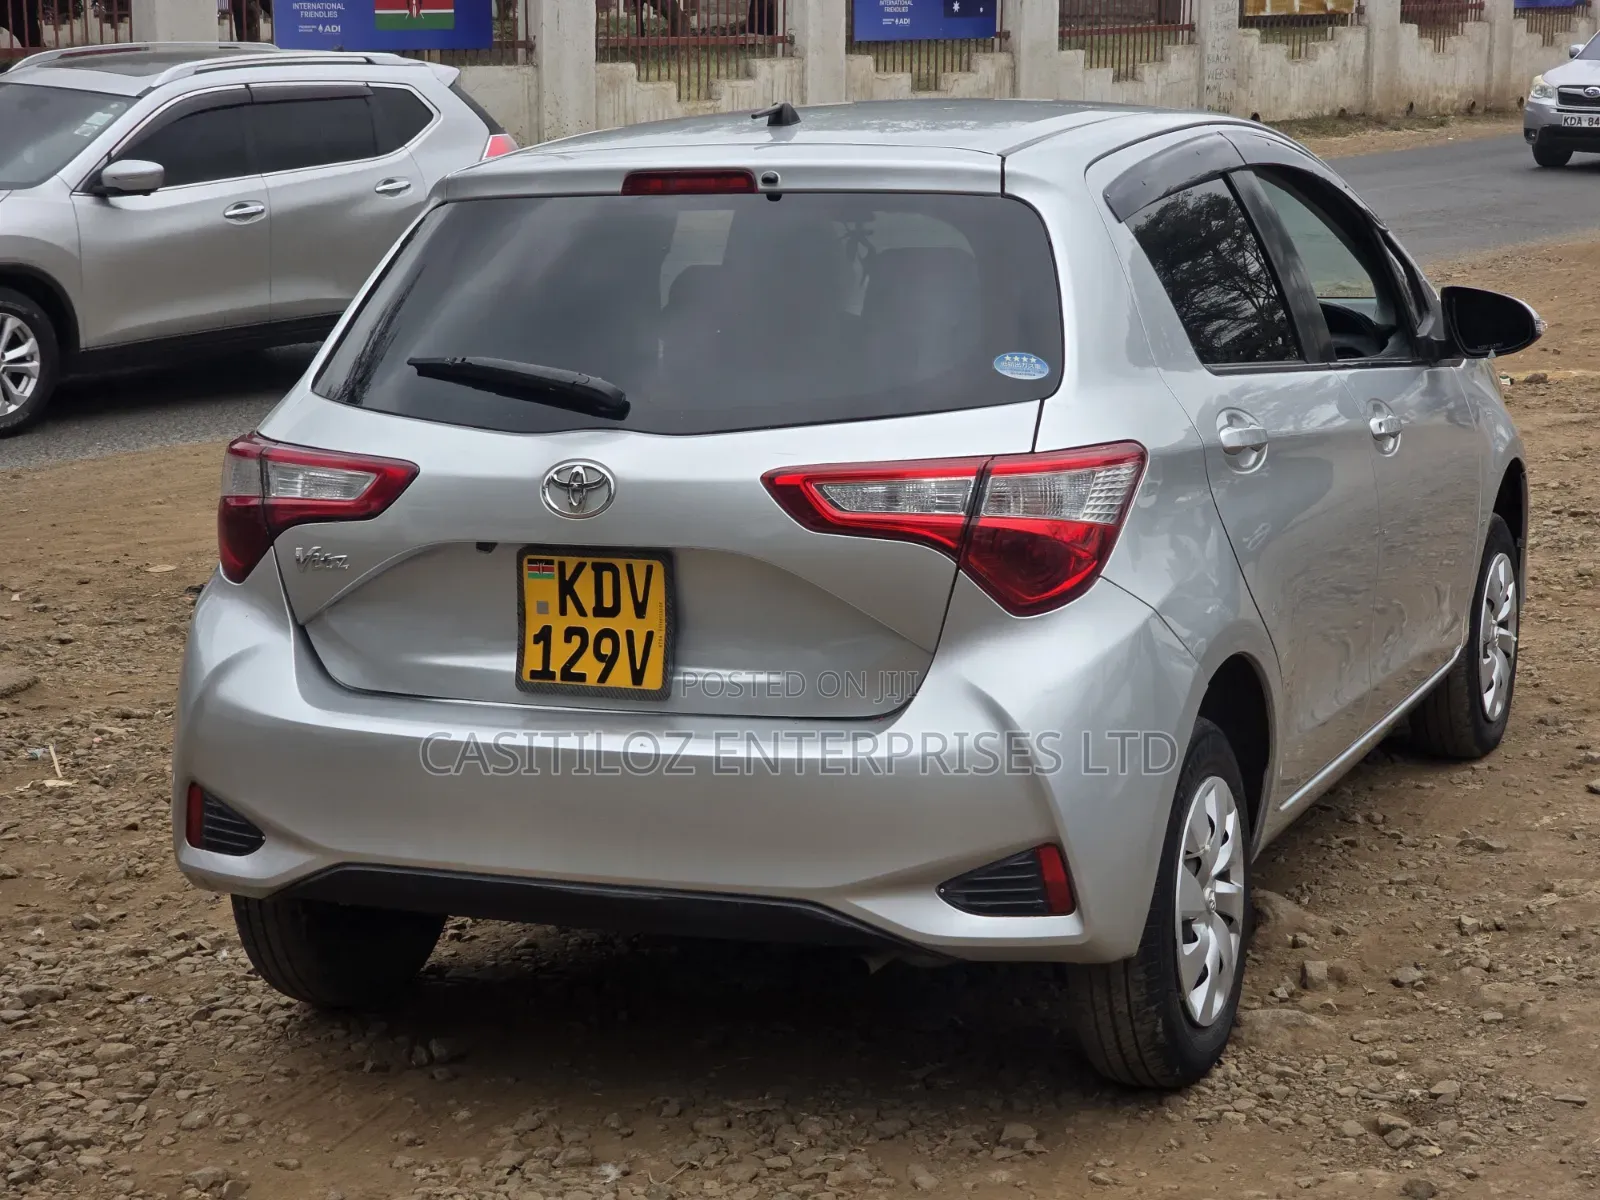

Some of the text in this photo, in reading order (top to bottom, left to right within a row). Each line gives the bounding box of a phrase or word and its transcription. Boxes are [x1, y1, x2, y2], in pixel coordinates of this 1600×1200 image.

[292, 2, 345, 10] INTERNATIONAL
[300, 10, 338, 18] FRIENDLIES
[1563, 116, 1583, 126] KDA
[557, 560, 654, 619] KDV
[529, 624, 655, 687] 129V
